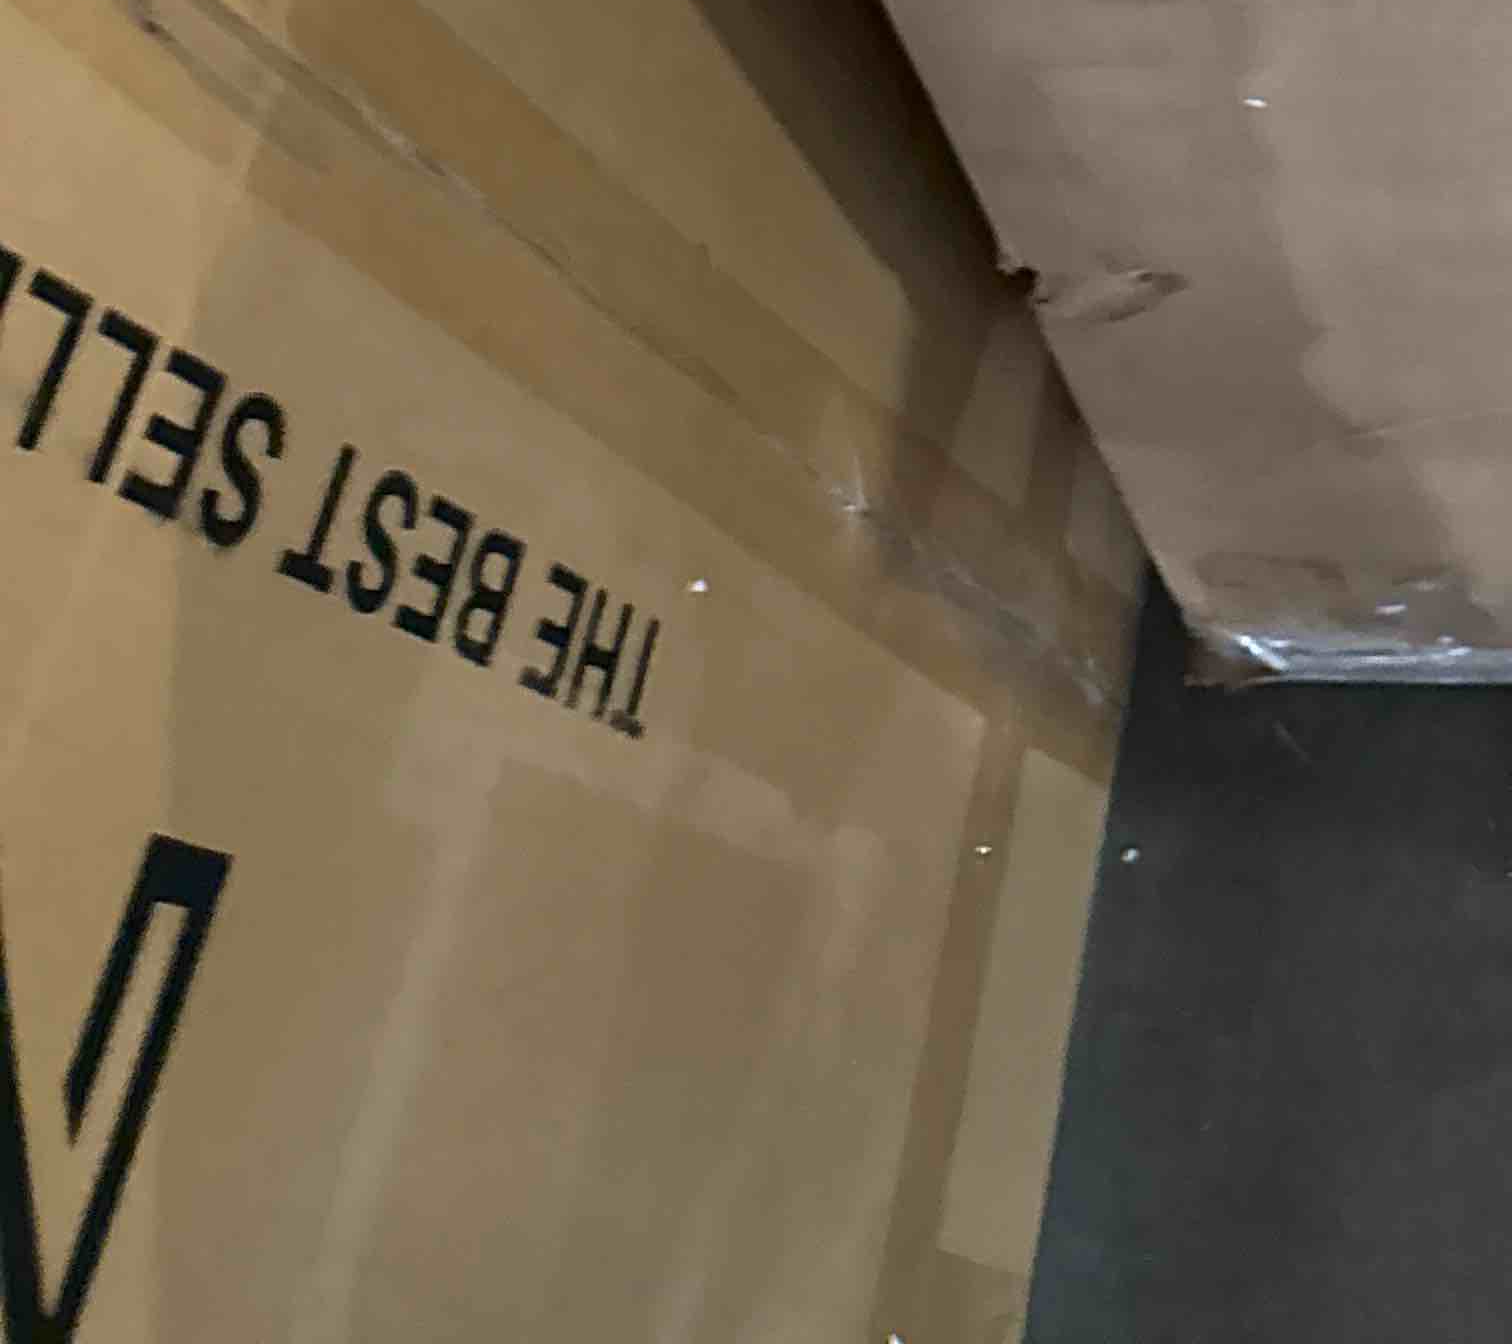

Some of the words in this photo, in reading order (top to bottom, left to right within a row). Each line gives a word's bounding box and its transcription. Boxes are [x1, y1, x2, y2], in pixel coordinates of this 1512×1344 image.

[0, 244, 288, 548] SELL
[276, 444, 528, 668] BEST
[517, 563, 661, 740] THE
